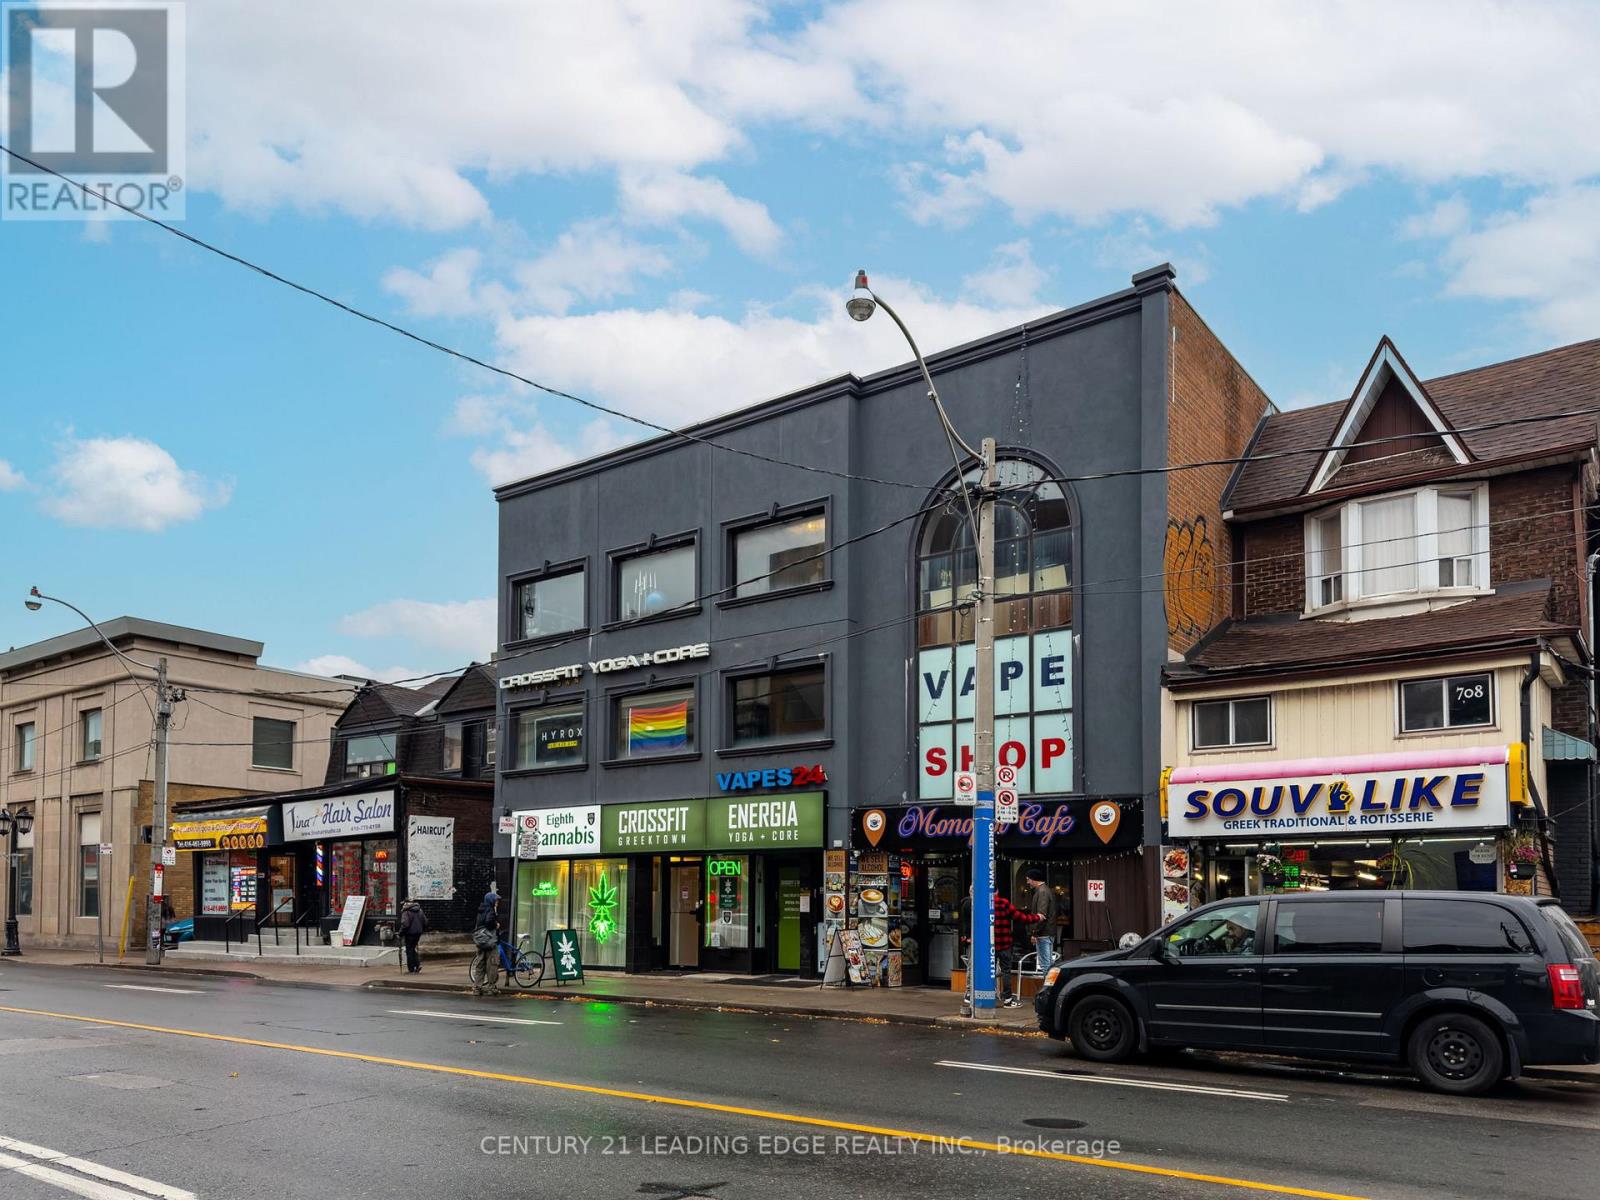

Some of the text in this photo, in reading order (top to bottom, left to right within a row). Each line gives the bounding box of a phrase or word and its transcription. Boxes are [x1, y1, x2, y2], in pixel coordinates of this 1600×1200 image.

[500, 664, 583, 689] CROSSFIT
[1455, 684, 1484, 700] 708
[541, 727, 583, 741] HYROX
[322, 801, 352, 825] Hair
[354, 797, 392, 824] Salon
[728, 800, 799, 829] ENERGIA
[546, 812, 574, 828] Eighth
[618, 807, 689, 834] CROSSFIT
[1017, 802, 1074, 846] Cafe
[1223, 812, 1434, 830] GREEK TRADITIONAL & ROTISSERIE
[416, 824, 446, 837] HAIRCUT
[728, 831, 754, 843] YOGA
[772, 830, 799, 841] CORE
[618, 834, 687, 847] GREEKTOWN
[709, 860, 741, 876] OPEN
[1088, 882, 1104, 891] FDC
